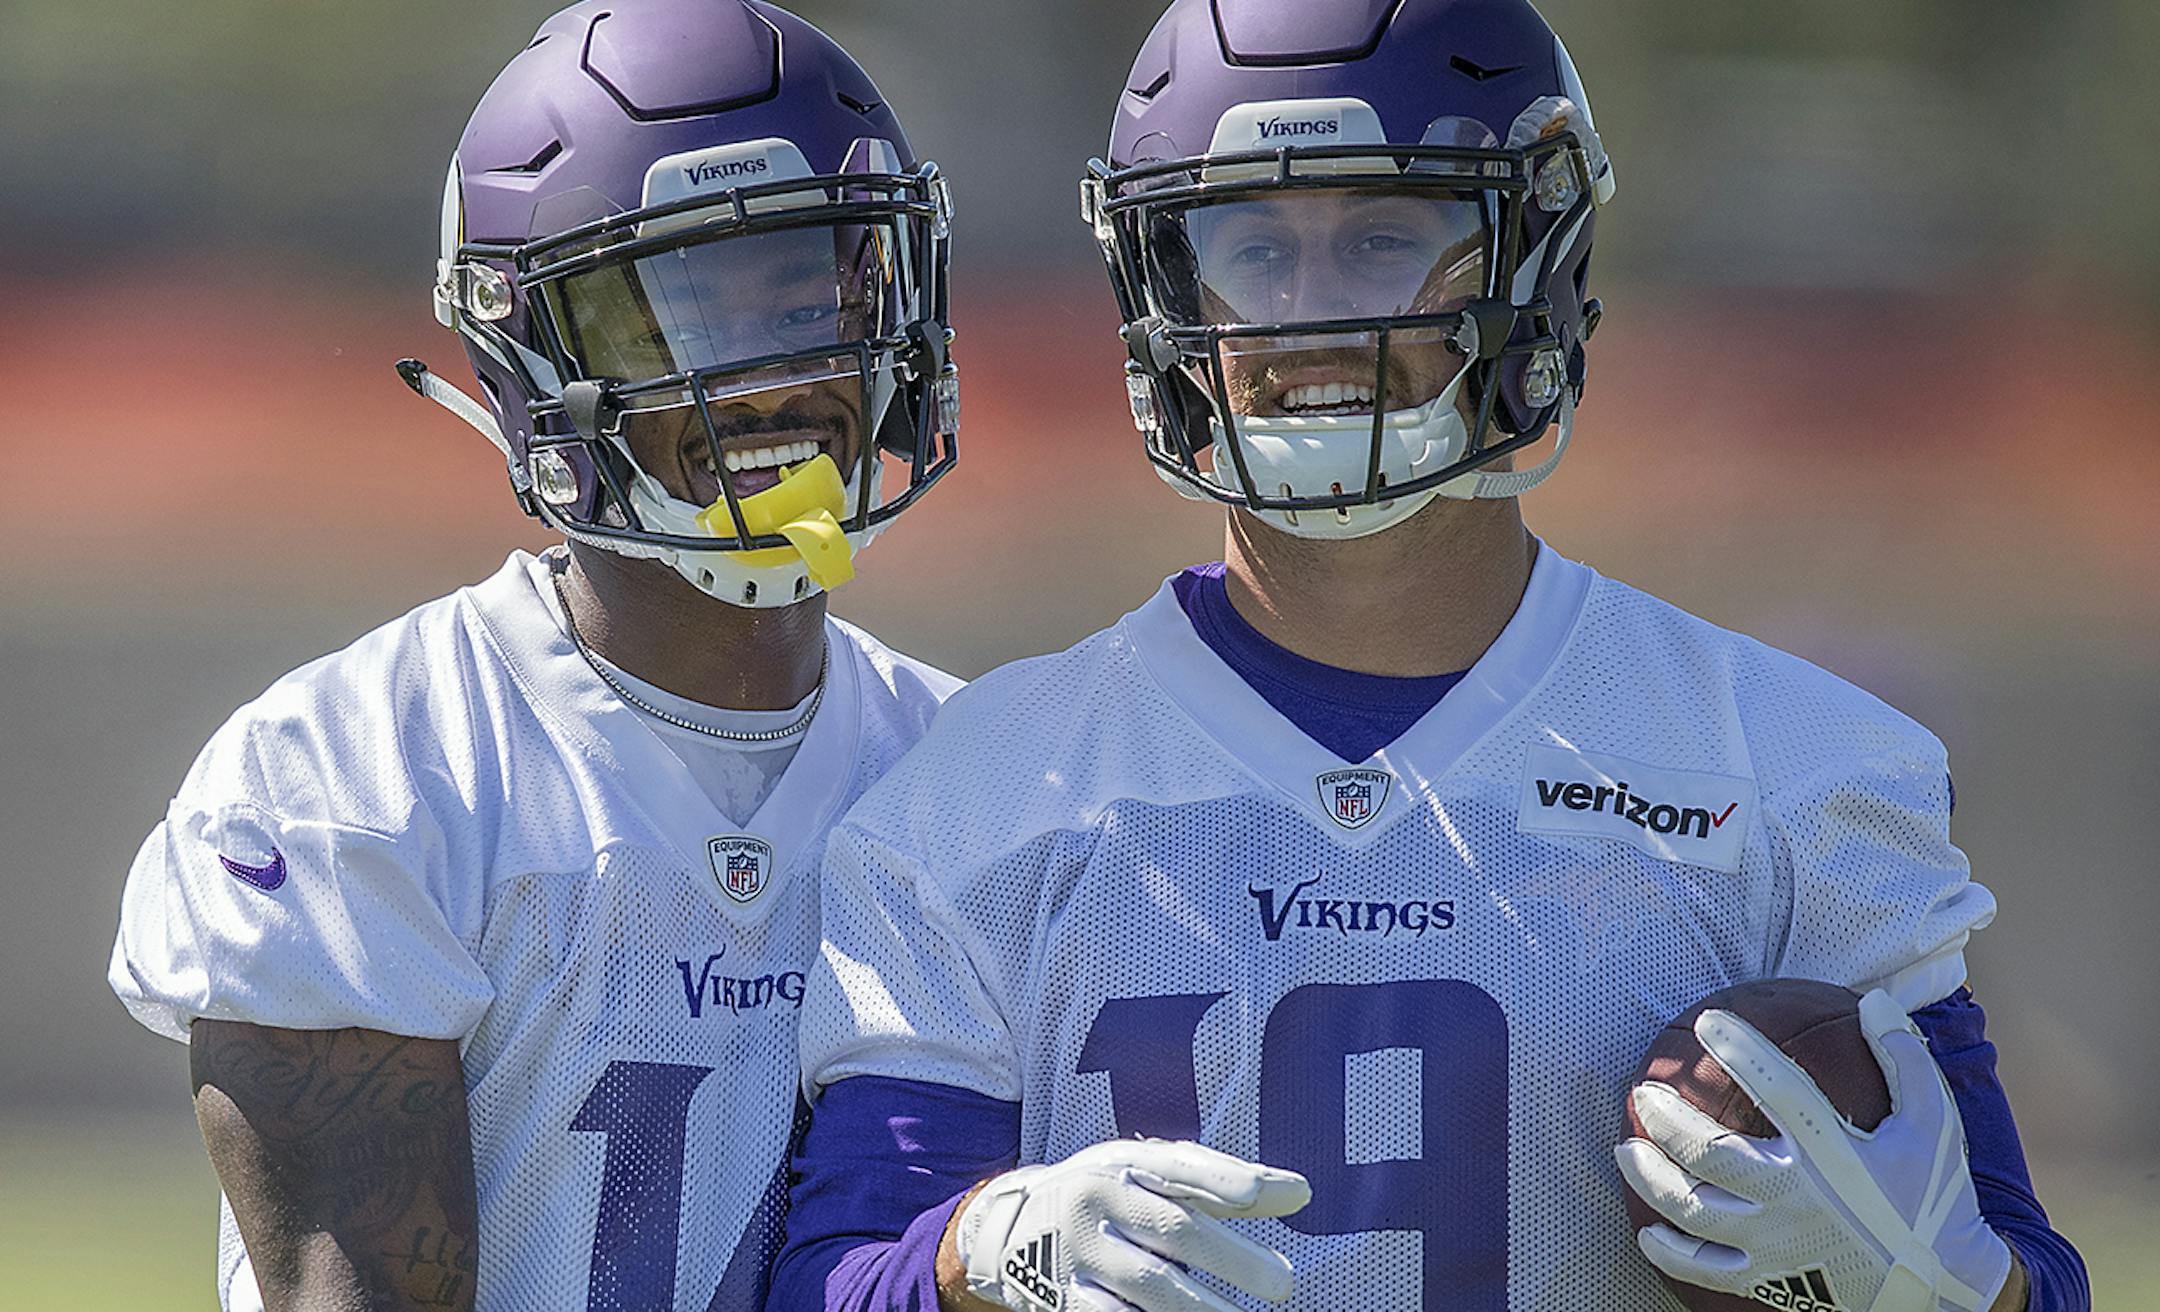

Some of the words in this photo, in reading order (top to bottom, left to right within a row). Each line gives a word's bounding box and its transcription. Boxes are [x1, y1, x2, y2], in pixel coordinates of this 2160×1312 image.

[1322, 772, 1385, 785] EQUIPMENT
[1339, 799, 1368, 818] NFL
[1535, 779, 1711, 839] verizon
[714, 841, 769, 857] EQUIPMENT
[730, 870, 758, 892] NFL
[674, 942, 806, 1018] VIKING
[1754, 1285, 1843, 1312] adid
